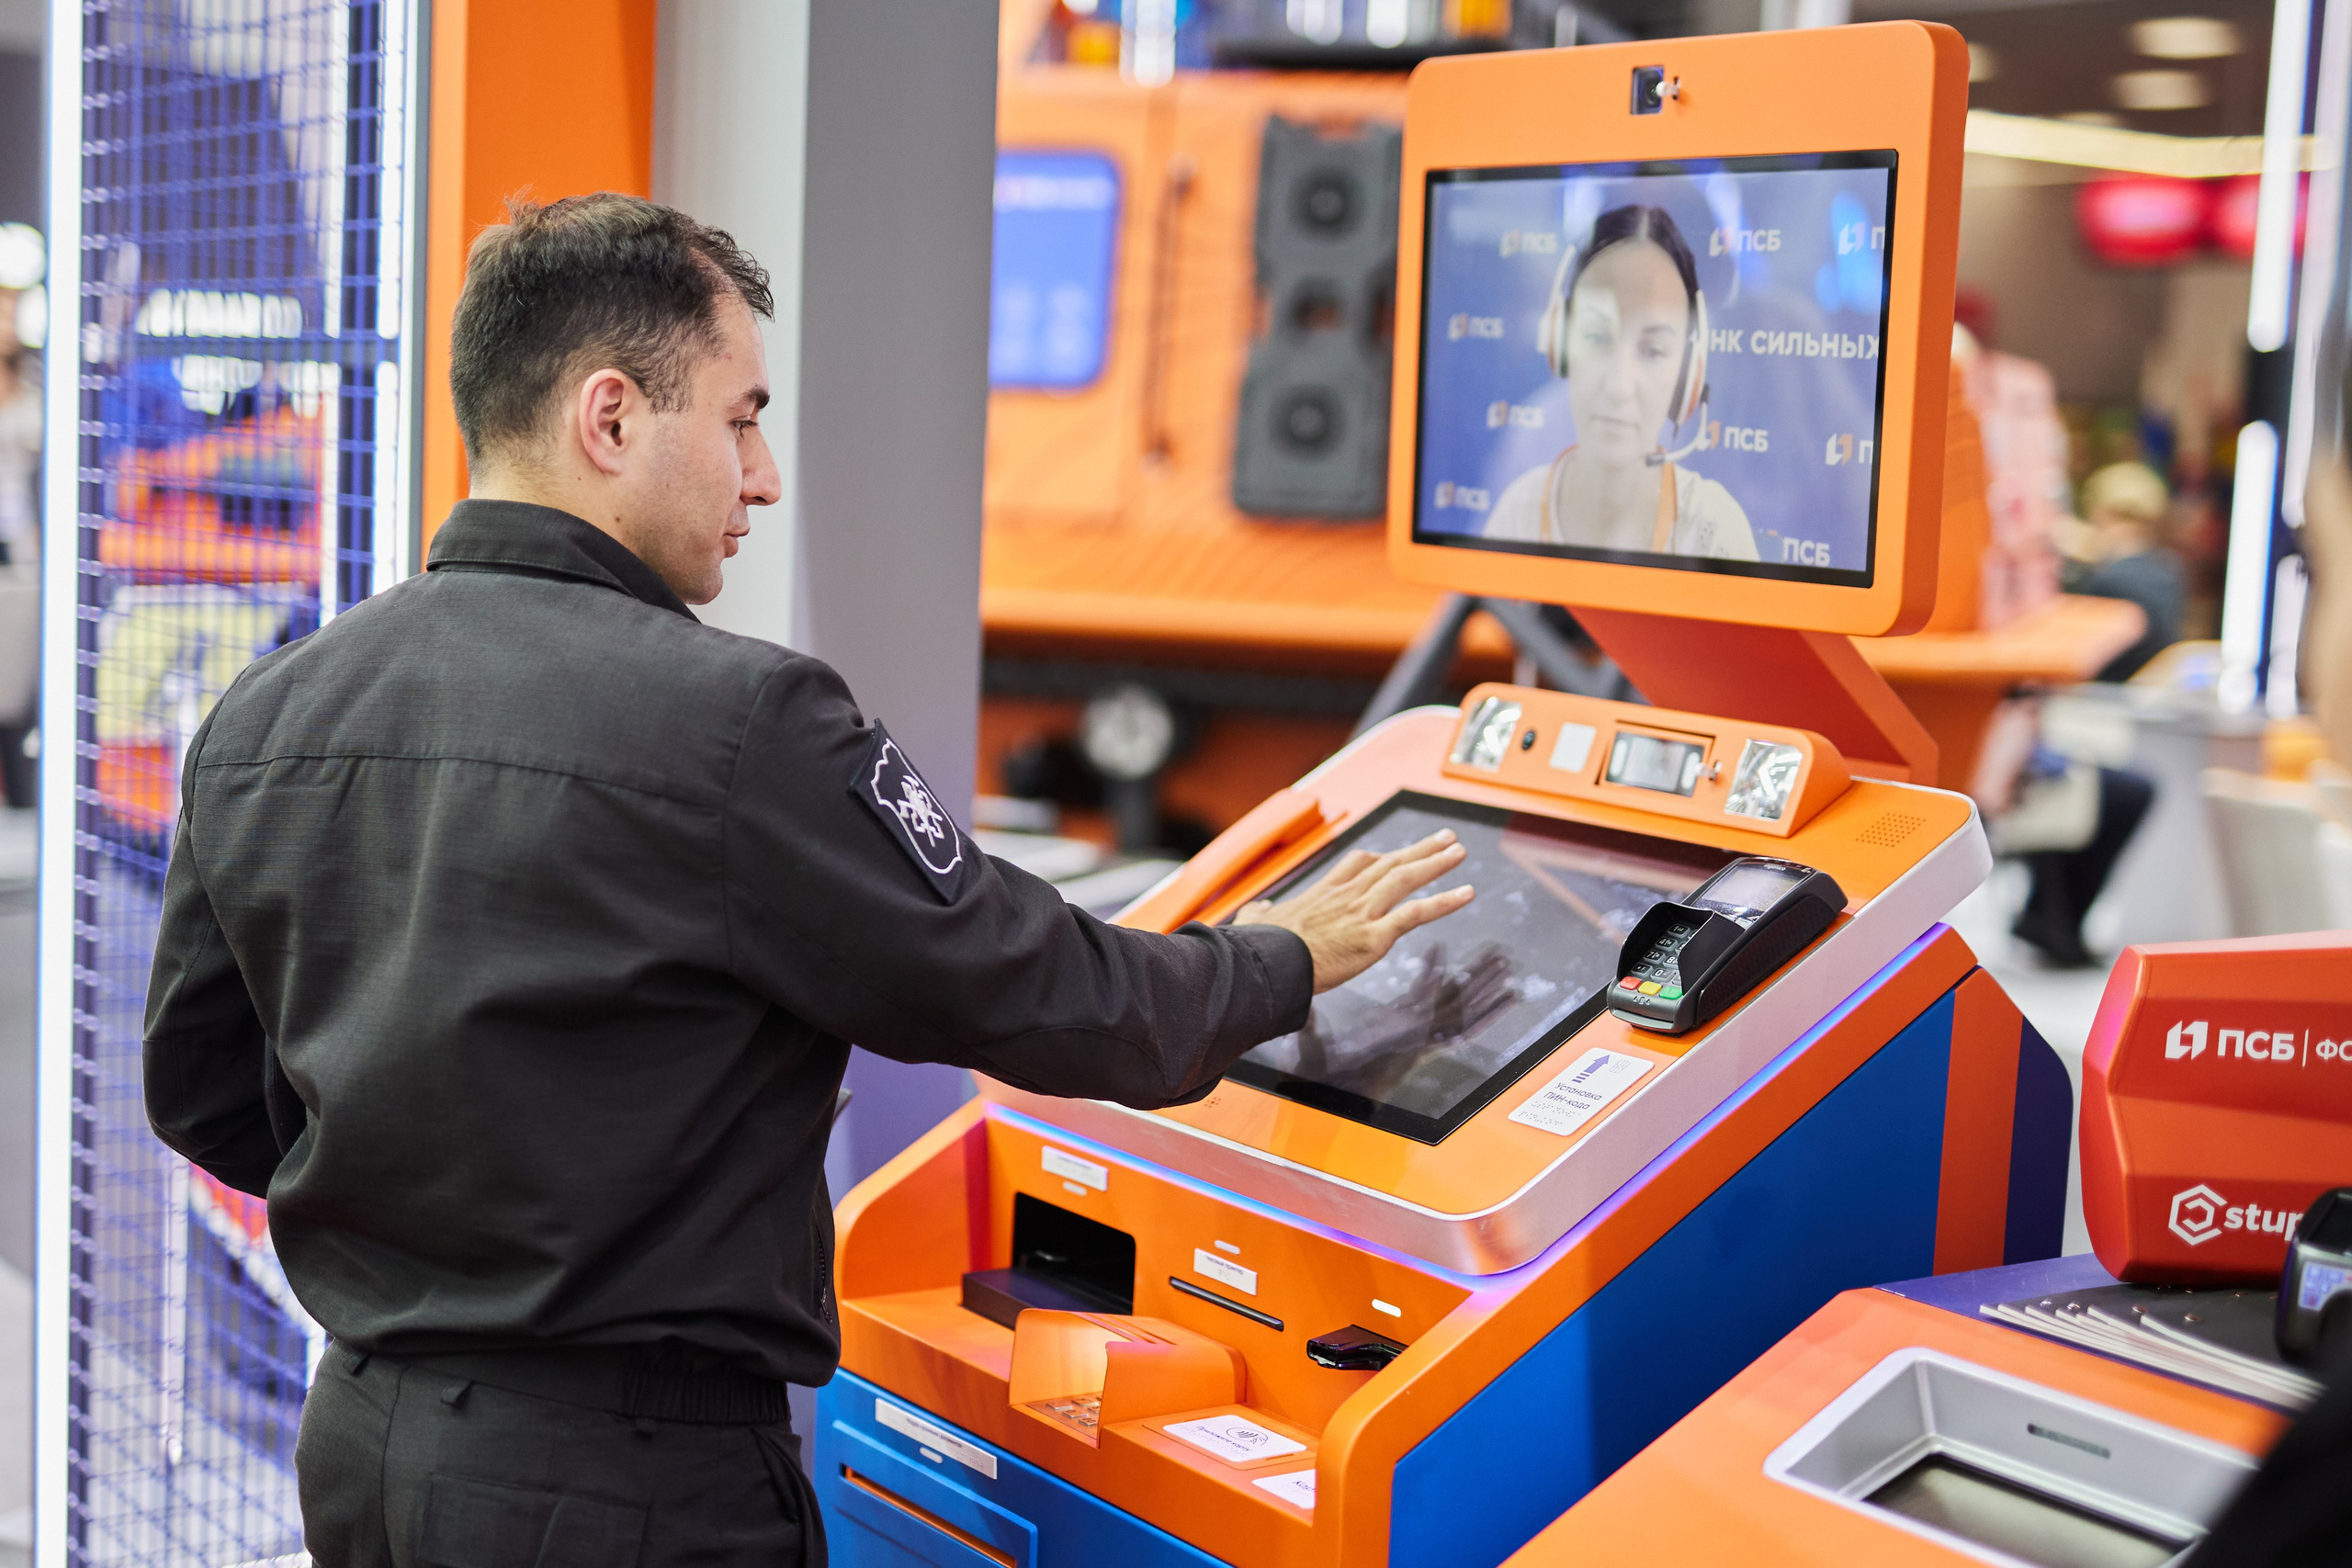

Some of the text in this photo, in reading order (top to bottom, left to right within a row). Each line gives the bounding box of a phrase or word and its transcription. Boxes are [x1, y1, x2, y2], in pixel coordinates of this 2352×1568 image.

[1521, 232, 1556, 254] ПСБ
[1737, 229, 1781, 253] ПСБ
[1469, 316, 1504, 339] ПСБ
[1710, 329, 1879, 359] НК СИЛЬНЫХ
[1509, 404, 1544, 429] ПСБ
[1724, 426, 1769, 452] ПСБ
[1455, 486, 1489, 512] ПСБ
[1782, 536, 1831, 567] ПСБ
[2217, 1029, 2295, 1060] ПСБ
[1544, 1091, 1590, 1111] ПИН-кода
[1555, 1082, 1602, 1101] Установка
[2223, 1203, 2305, 1242] stup
